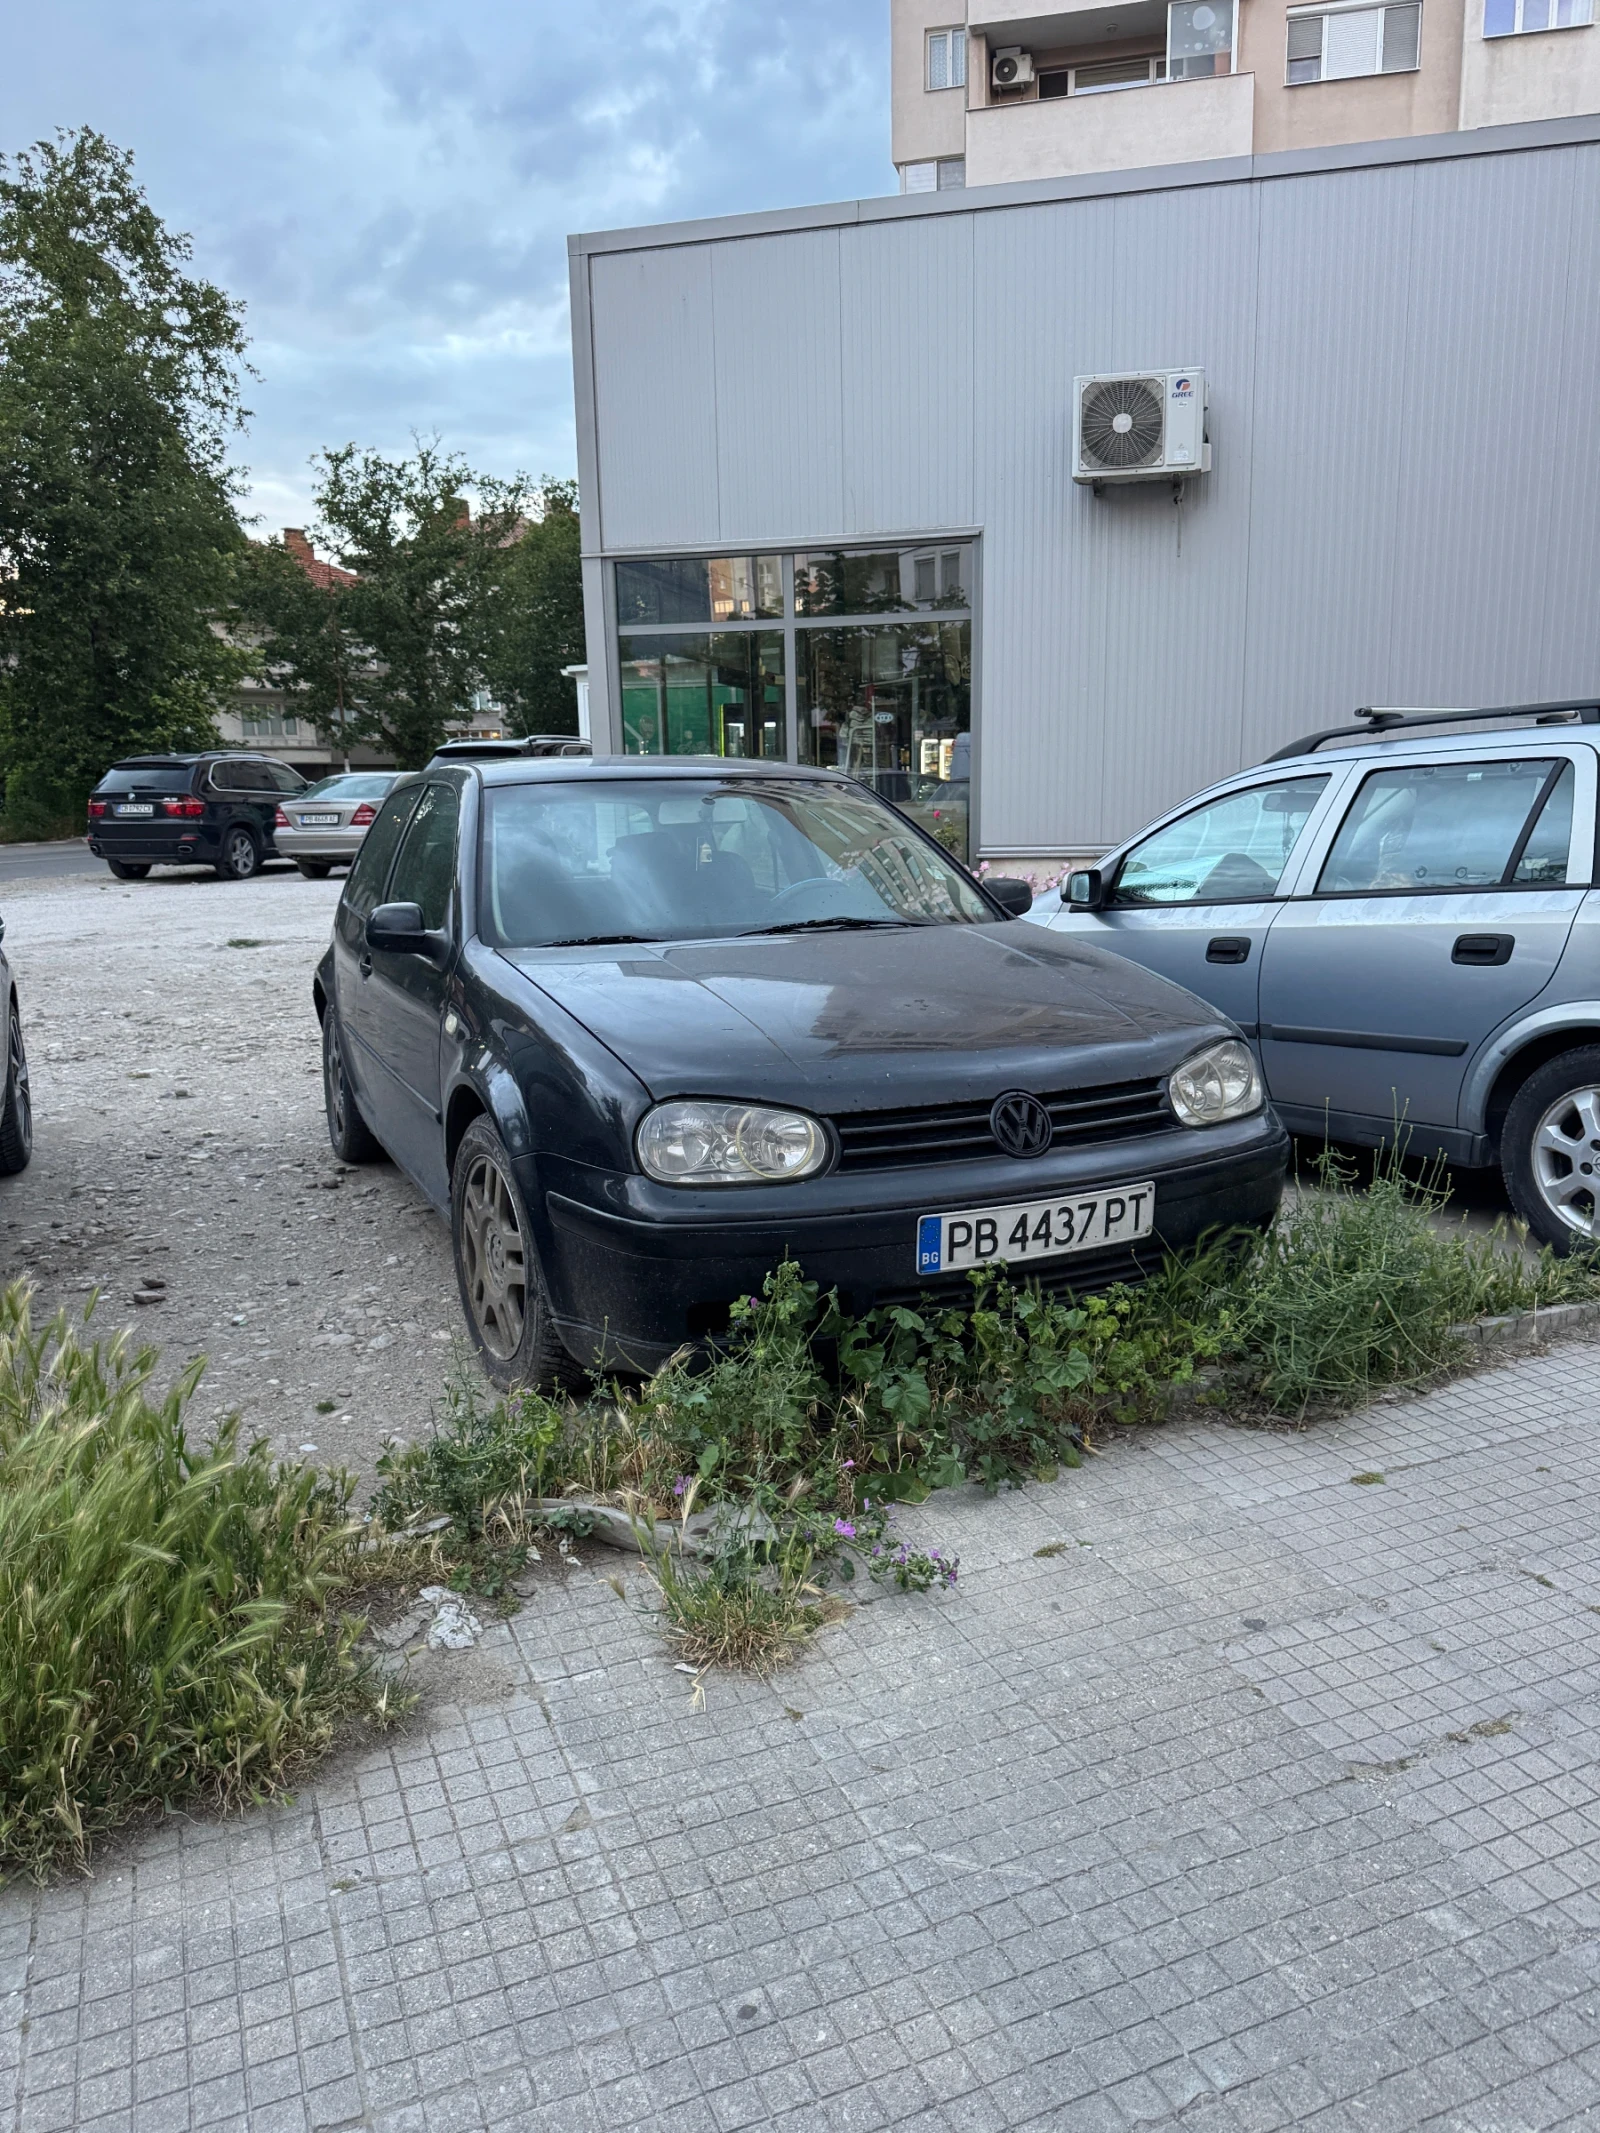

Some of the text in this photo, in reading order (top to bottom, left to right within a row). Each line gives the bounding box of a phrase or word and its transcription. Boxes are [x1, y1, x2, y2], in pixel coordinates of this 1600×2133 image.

[948, 1192, 1148, 1262] PB 4437 PT
[922, 1252, 939, 1265] BG
